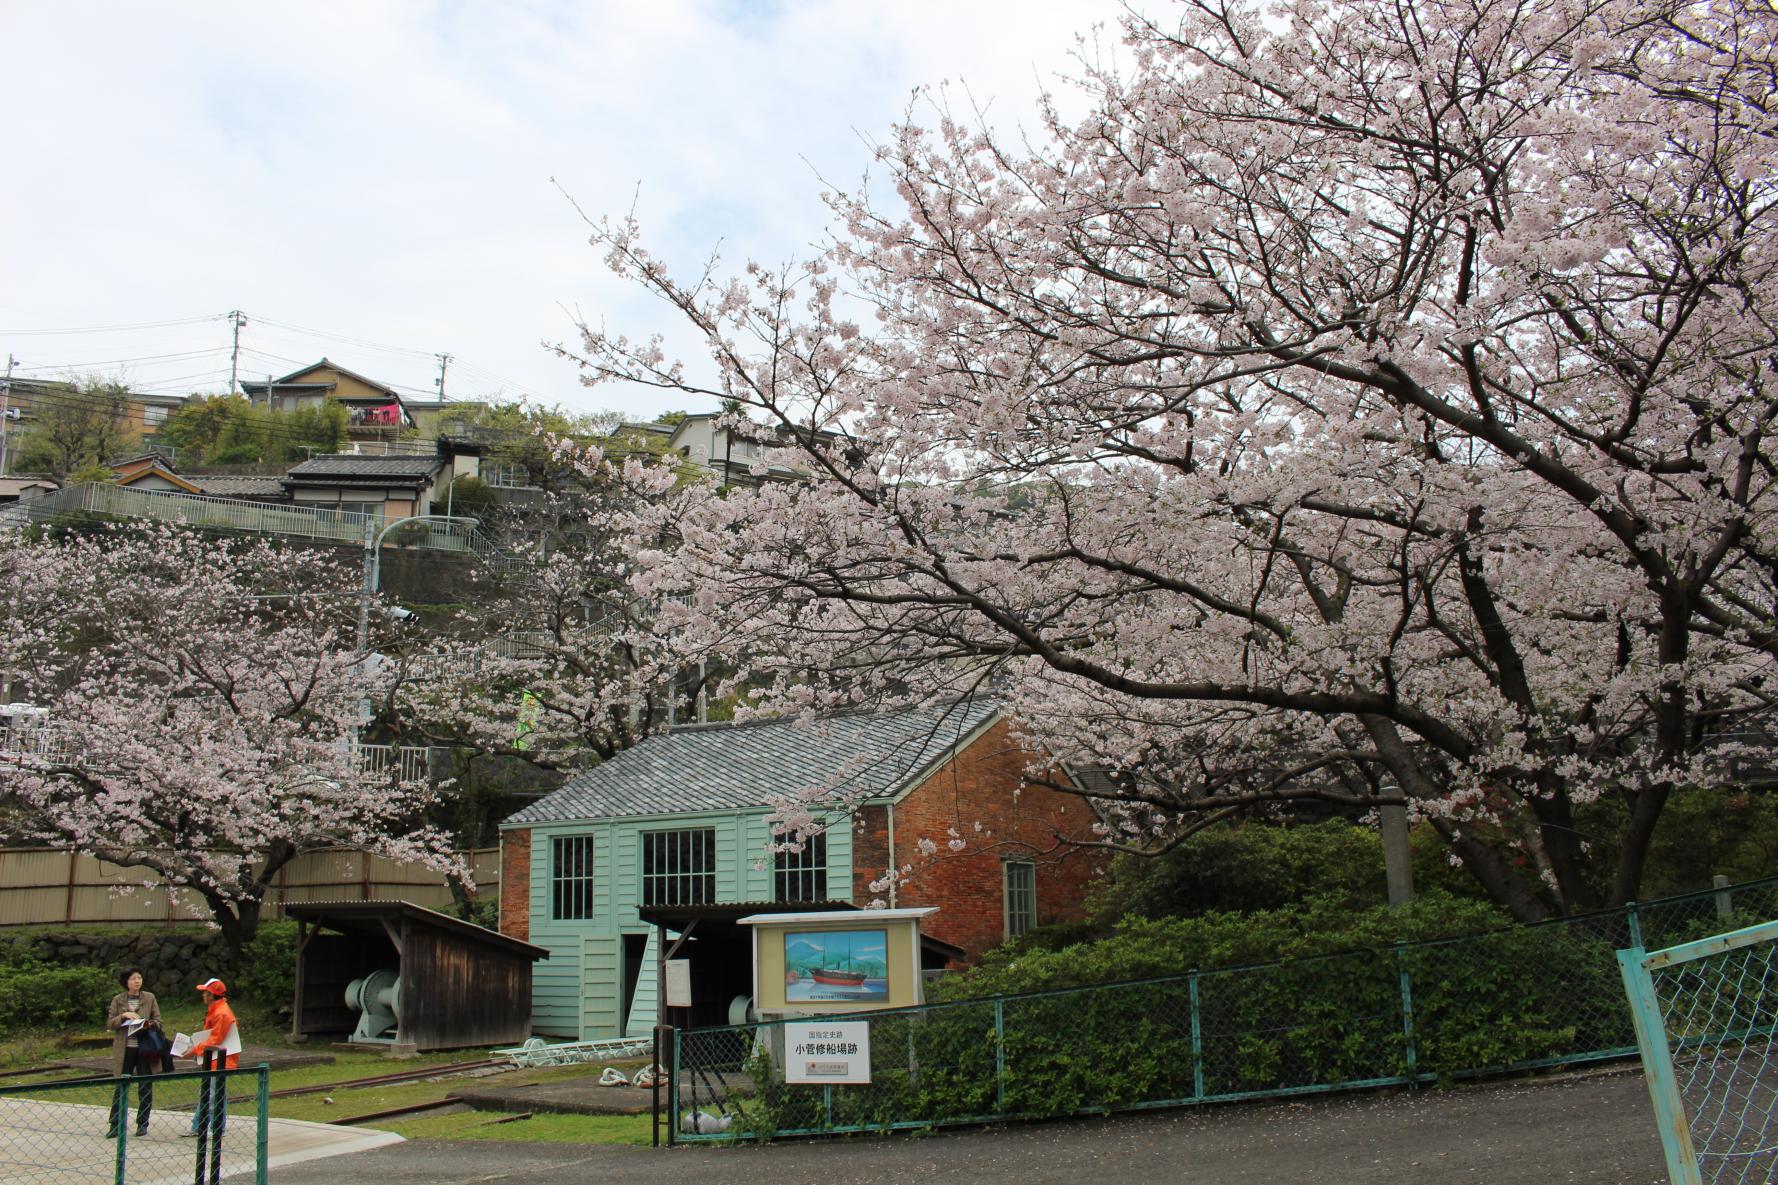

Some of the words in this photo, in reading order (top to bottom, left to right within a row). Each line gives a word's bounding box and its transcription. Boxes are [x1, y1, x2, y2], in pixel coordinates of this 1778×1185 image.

[795, 1043, 858, 1055] 小菅修船場跡
